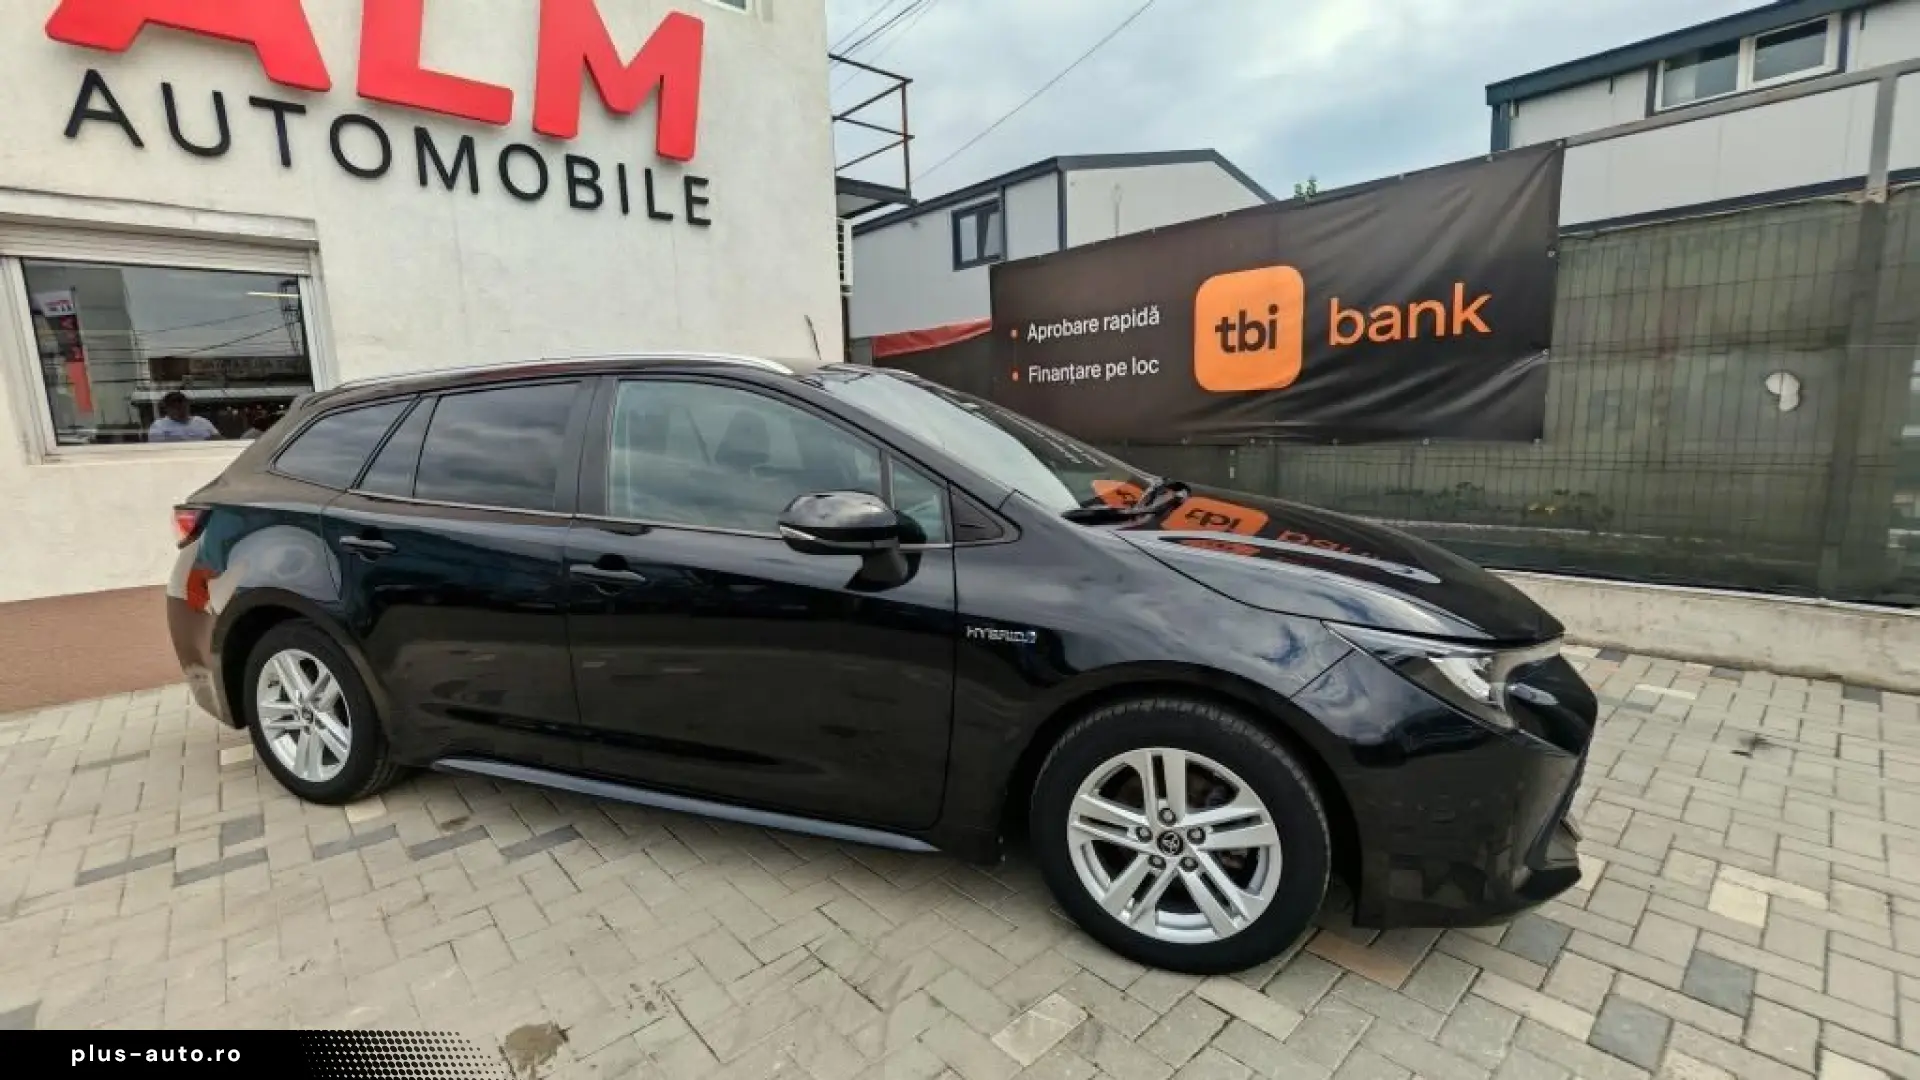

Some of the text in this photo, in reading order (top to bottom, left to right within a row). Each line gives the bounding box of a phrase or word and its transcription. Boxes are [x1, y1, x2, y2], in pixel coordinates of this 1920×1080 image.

[64, 69, 711, 227] AUTOMOBILE
[1027, 305, 1160, 343] Aprobare rapidă
[1215, 282, 1492, 353] tbi bank
[1028, 356, 1159, 386] Finanțare pe loc
